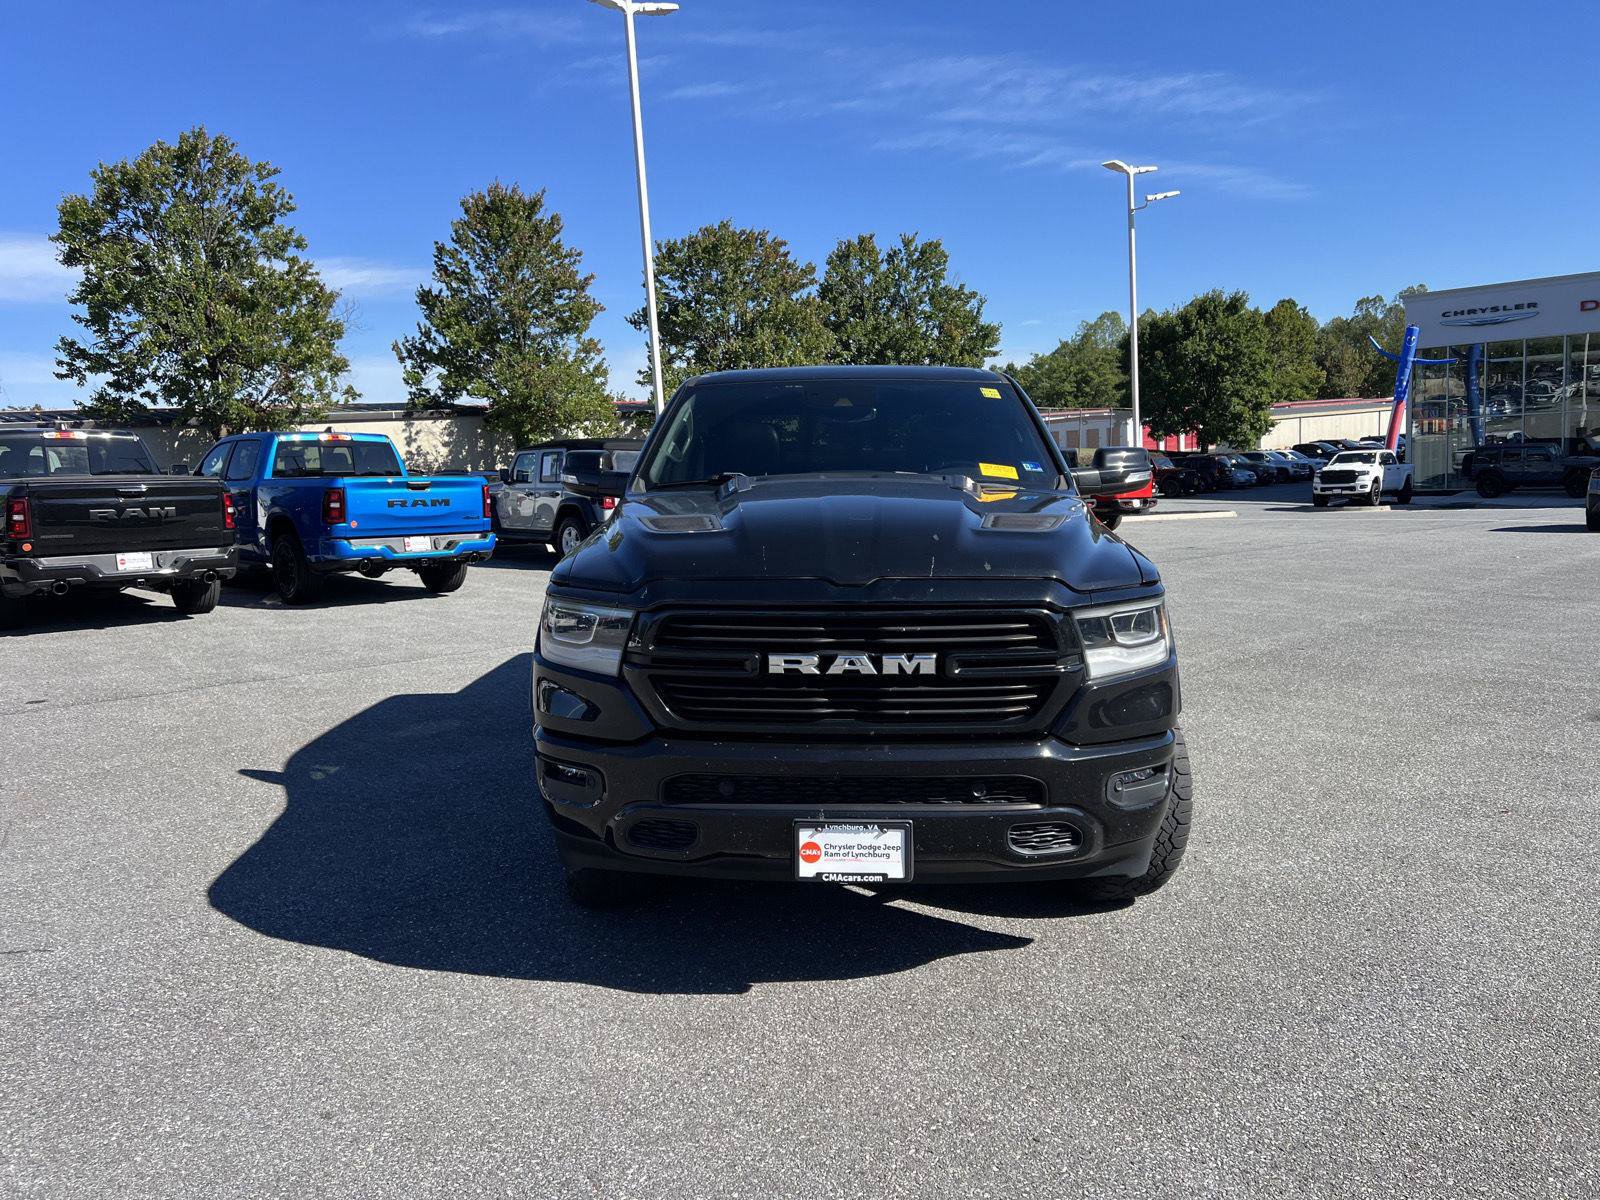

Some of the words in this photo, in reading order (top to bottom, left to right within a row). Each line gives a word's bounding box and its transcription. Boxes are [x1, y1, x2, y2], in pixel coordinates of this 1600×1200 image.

[1441, 302, 1538, 318] CHRYSLER
[387, 498, 451, 508] RAM
[89, 506, 177, 520] RAM
[768, 653, 937, 675] RAM
[824, 843, 855, 851] Chrysler
[857, 843, 881, 851] Dodge
[882, 844, 901, 852] Jeep
[842, 850, 850, 858] of
[851, 851, 891, 859] Lynchburg
[822, 873, 883, 882] CMAcars.com
